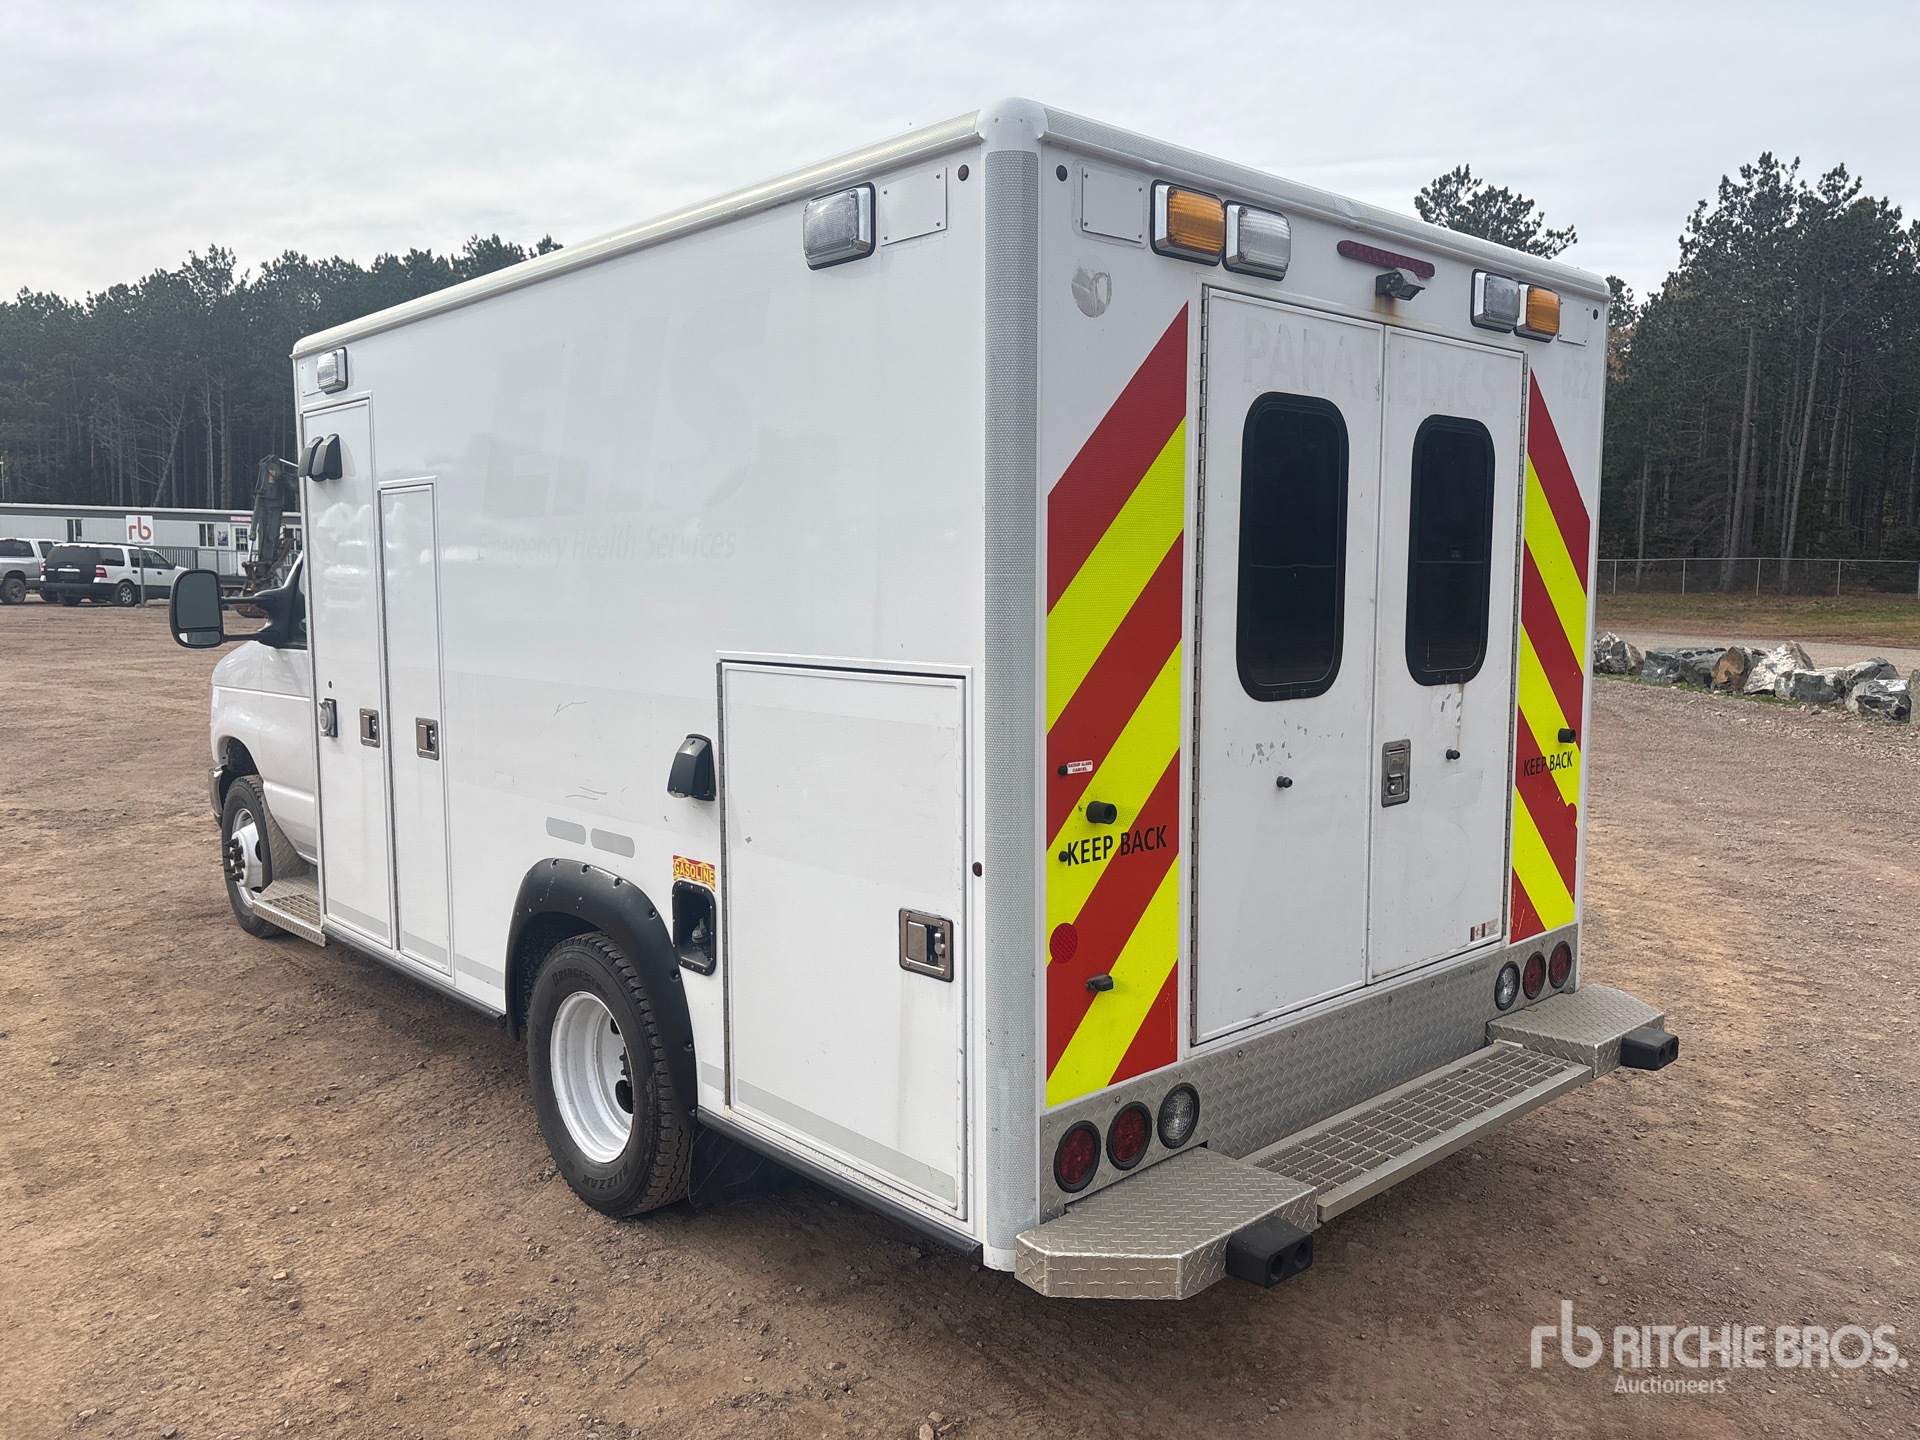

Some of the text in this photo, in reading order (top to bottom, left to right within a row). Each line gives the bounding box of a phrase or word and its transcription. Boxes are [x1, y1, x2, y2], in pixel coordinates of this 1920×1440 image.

[128, 516, 152, 540] rb
[1523, 751, 1573, 777] KEEP BACK
[1067, 825, 1167, 867] KEEP BACK
[673, 860, 715, 886] GASOLINE
